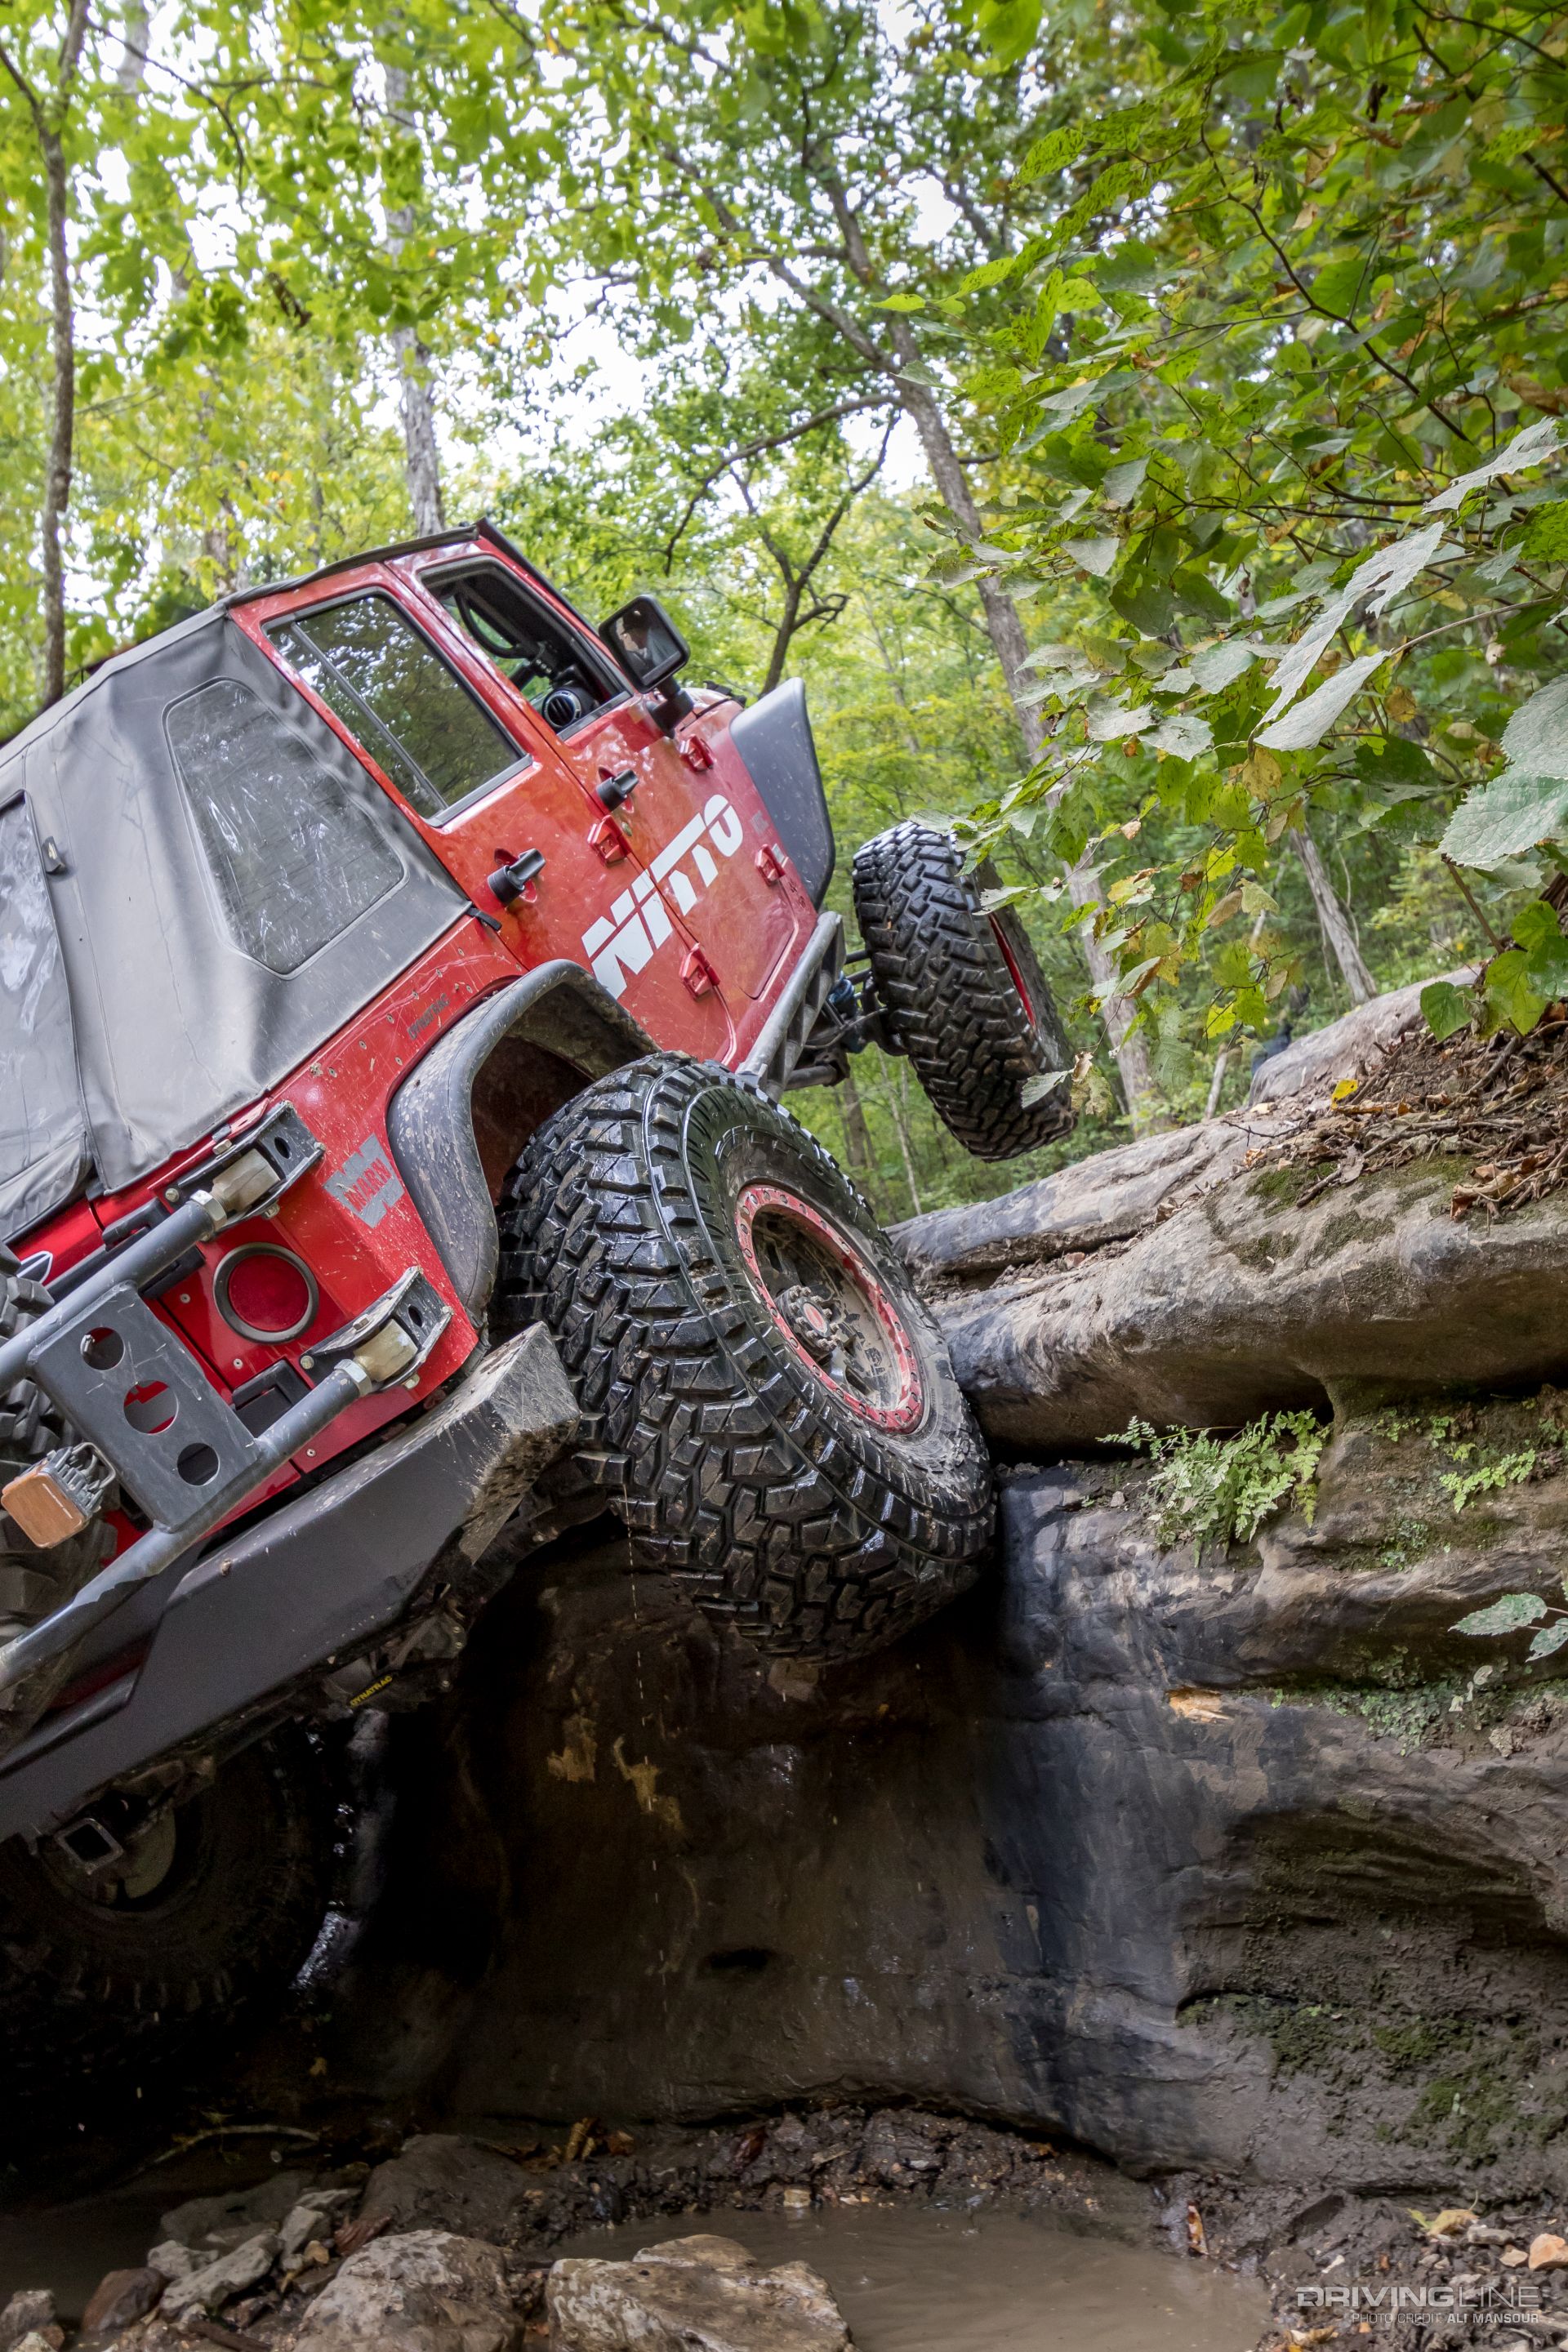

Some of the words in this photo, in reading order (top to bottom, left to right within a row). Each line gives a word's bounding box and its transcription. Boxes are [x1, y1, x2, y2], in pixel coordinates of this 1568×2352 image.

[581, 795, 743, 1000] NITTO
[342, 1157, 392, 1213] WARN
[350, 1676, 392, 1707] DYNATRAC
